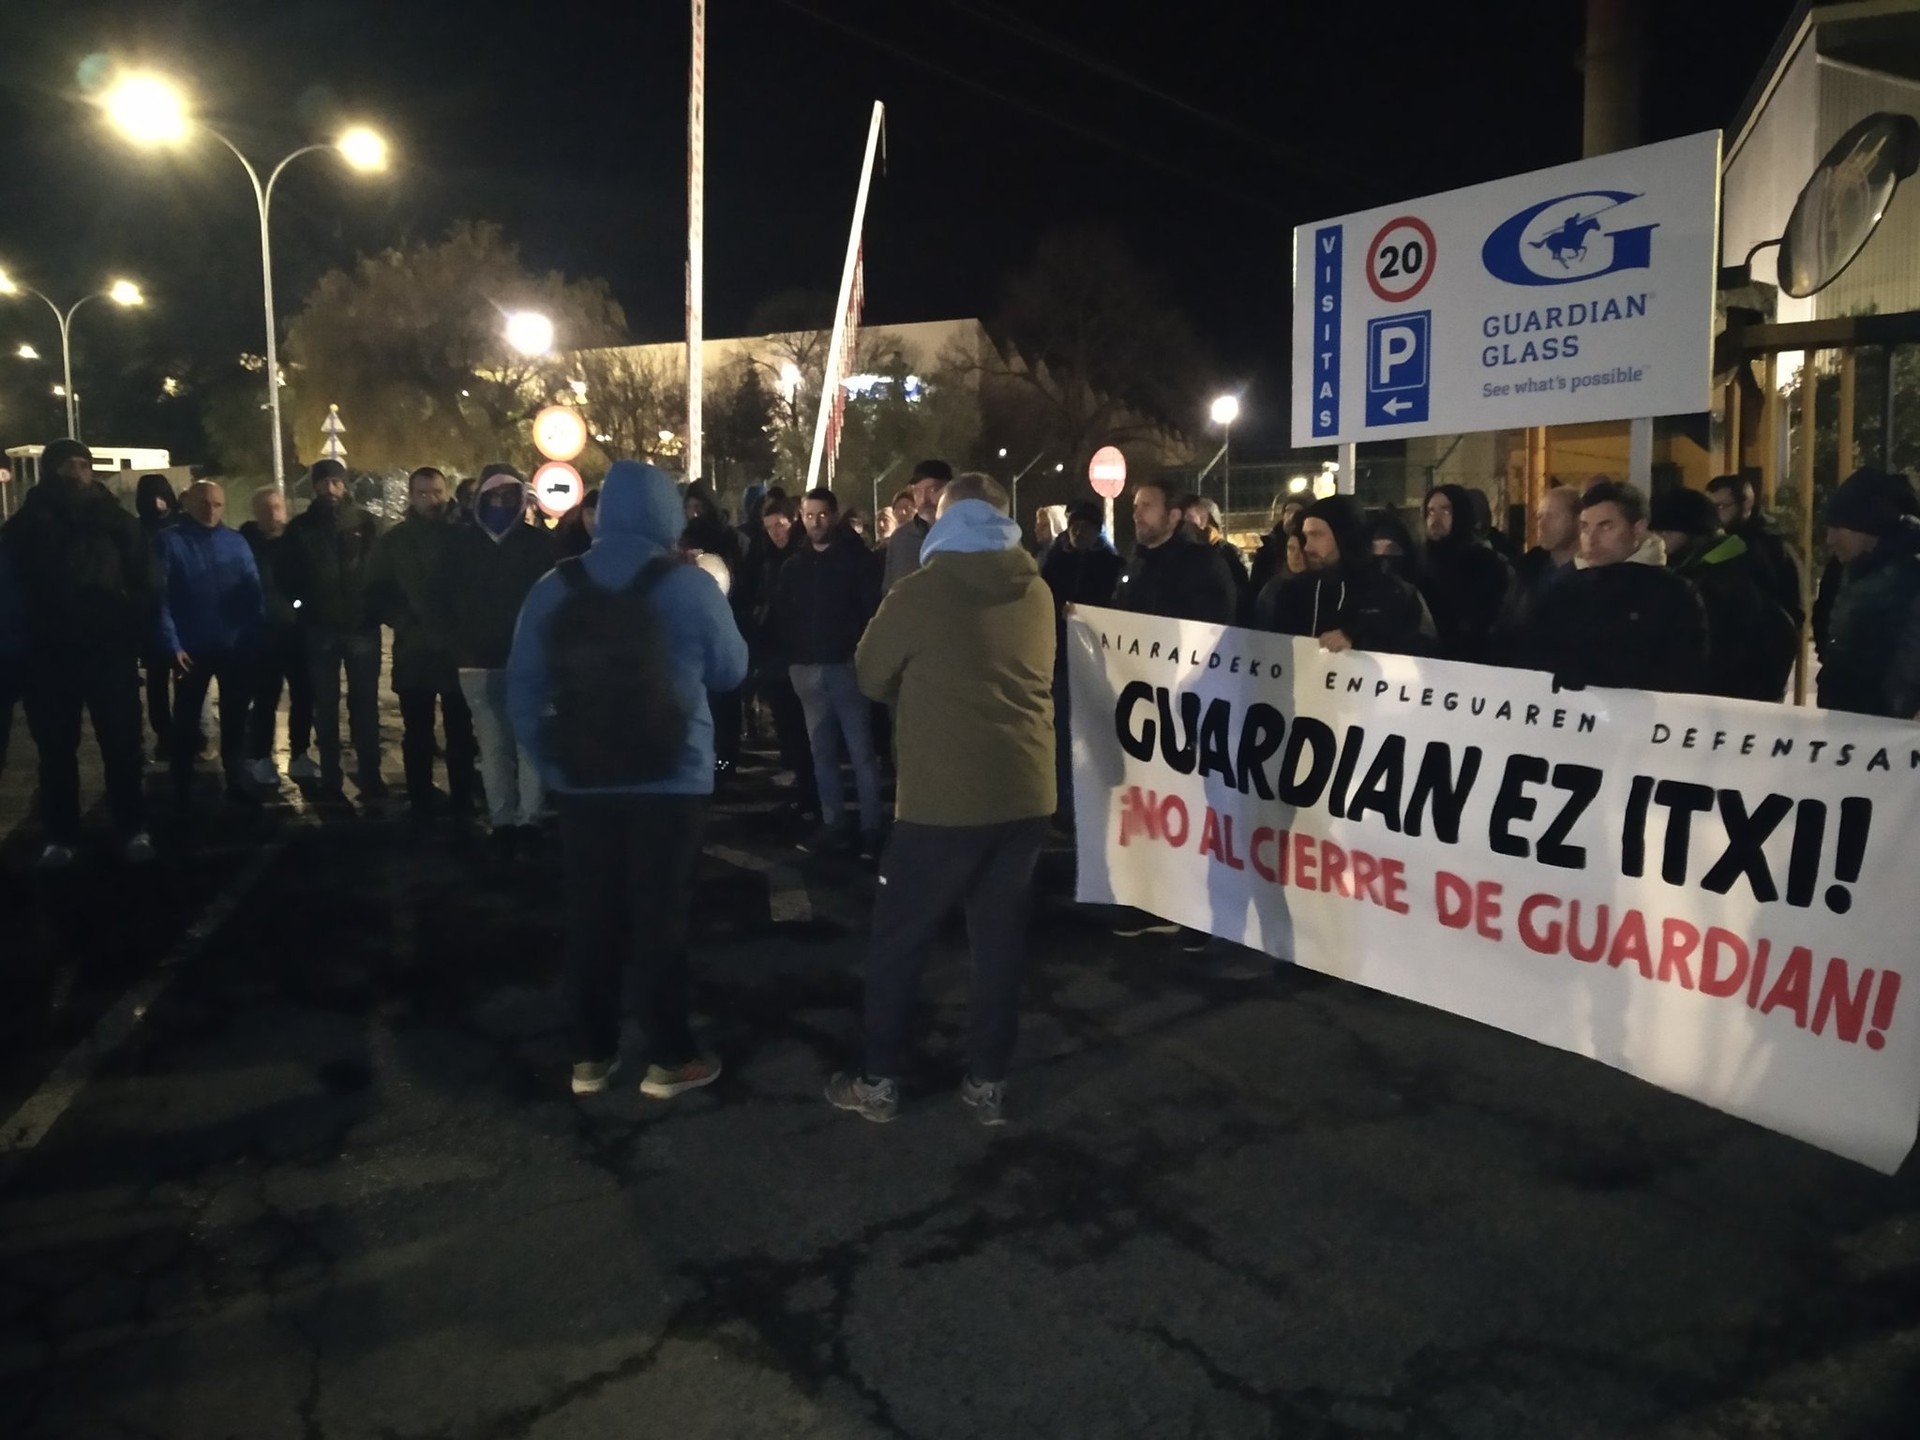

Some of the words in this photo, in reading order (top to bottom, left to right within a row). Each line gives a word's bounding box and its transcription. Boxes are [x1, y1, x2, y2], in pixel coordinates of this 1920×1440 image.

[1379, 241, 1423, 279] 20
[1319, 235, 1336, 428] VISITAS
[1483, 293, 1647, 338] GUARDIAN
[1380, 325, 1416, 384] P
[1482, 335, 1579, 367] GLASS
[1483, 383, 1510, 398] See
[1515, 375, 1567, 394] what's
[1571, 366, 1643, 393] possible
[1101, 633, 1282, 679] AIARALDEKO
[1325, 671, 1596, 733] ENPLEGUAREN
[1115, 680, 1483, 844] GUARDIAN
[1489, 754, 1603, 870] EZ
[1621, 775, 1873, 915] ITXI!
[1119, 785, 1190, 848] ¡NO
[1198, 806, 1245, 871] AL
[1250, 826, 1410, 915] CIERRE
[1435, 871, 1503, 942] DE
[1517, 893, 1902, 1051] GUARDIAN!
